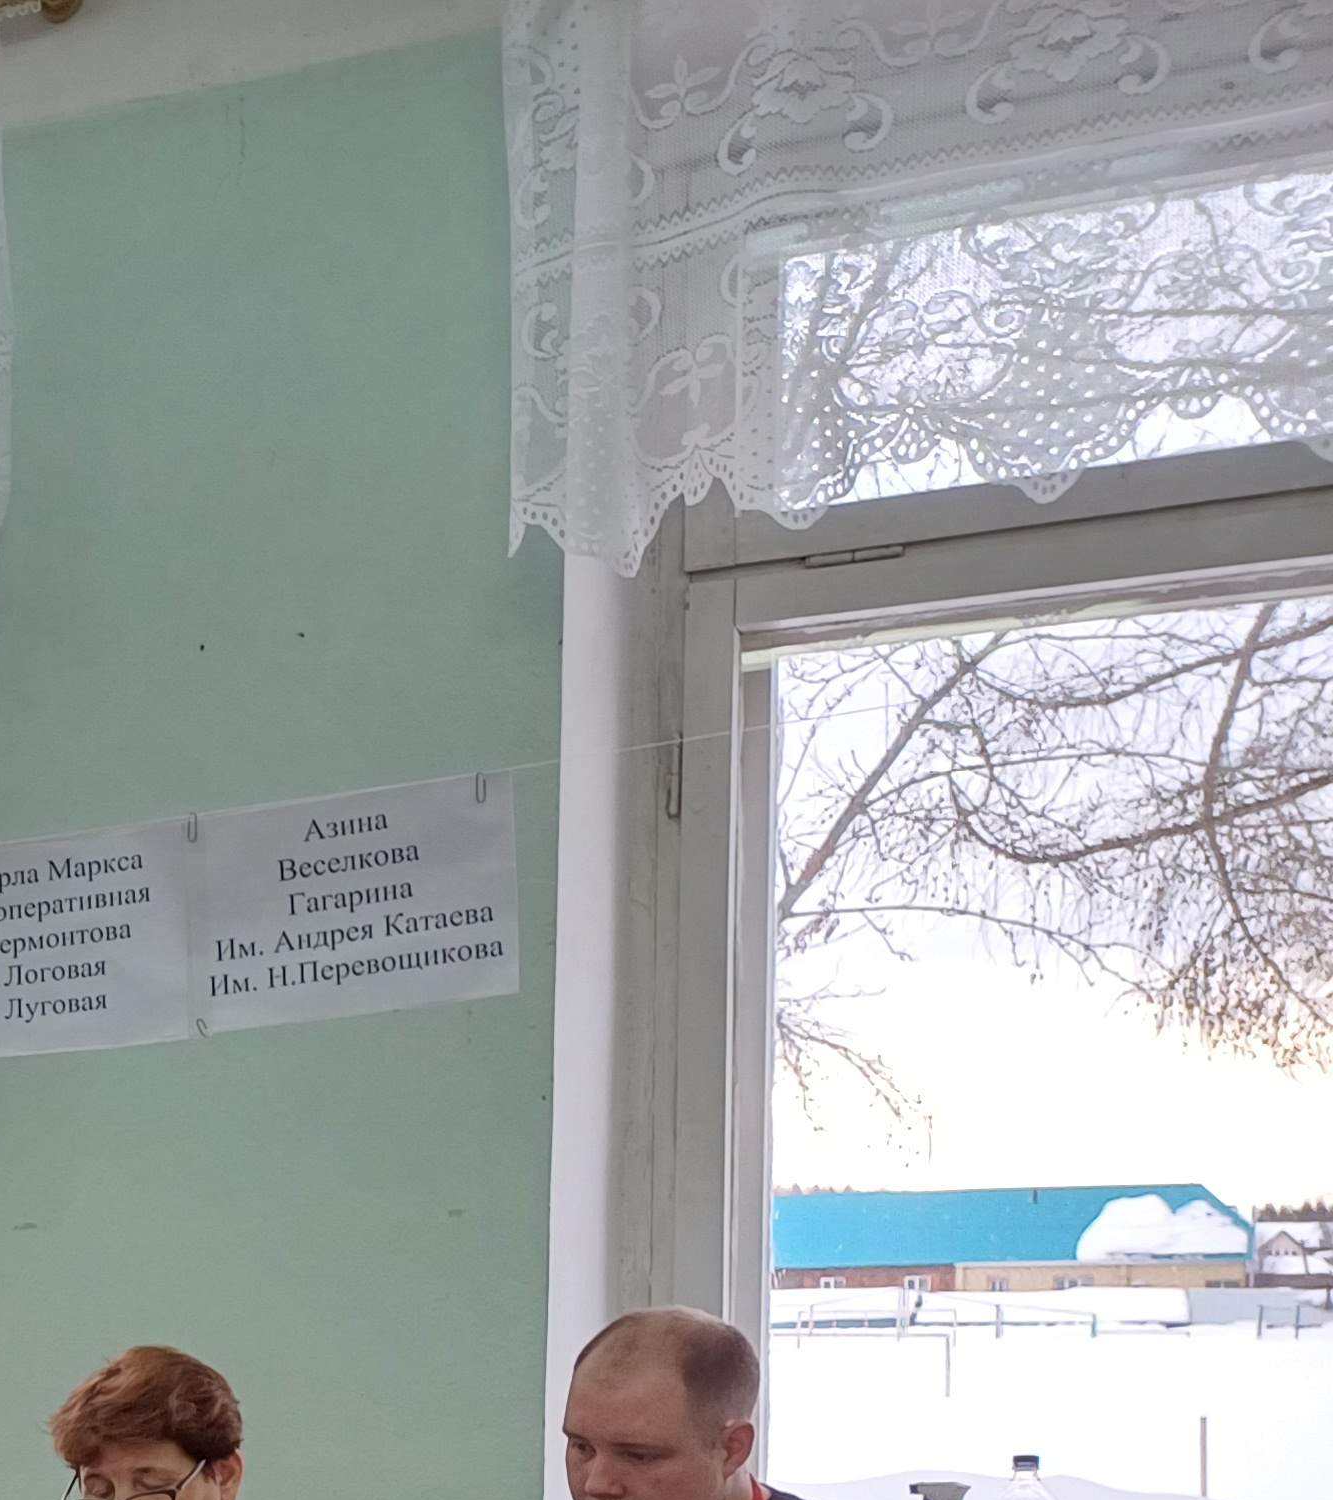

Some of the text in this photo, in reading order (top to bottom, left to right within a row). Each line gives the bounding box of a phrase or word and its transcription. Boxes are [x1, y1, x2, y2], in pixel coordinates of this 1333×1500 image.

[303, 813, 389, 843] Азина
[47, 853, 143, 883] Маркса
[277, 844, 420, 882] Веселкова
[287, 882, 414, 916] Гагарина
[215, 905, 494, 962] Им. Андрея Катаева
[3, 960, 106, 988] Логовая
[209, 940, 504, 998] Им. Н.Перевощикова
[4, 994, 107, 1024] Луговая
